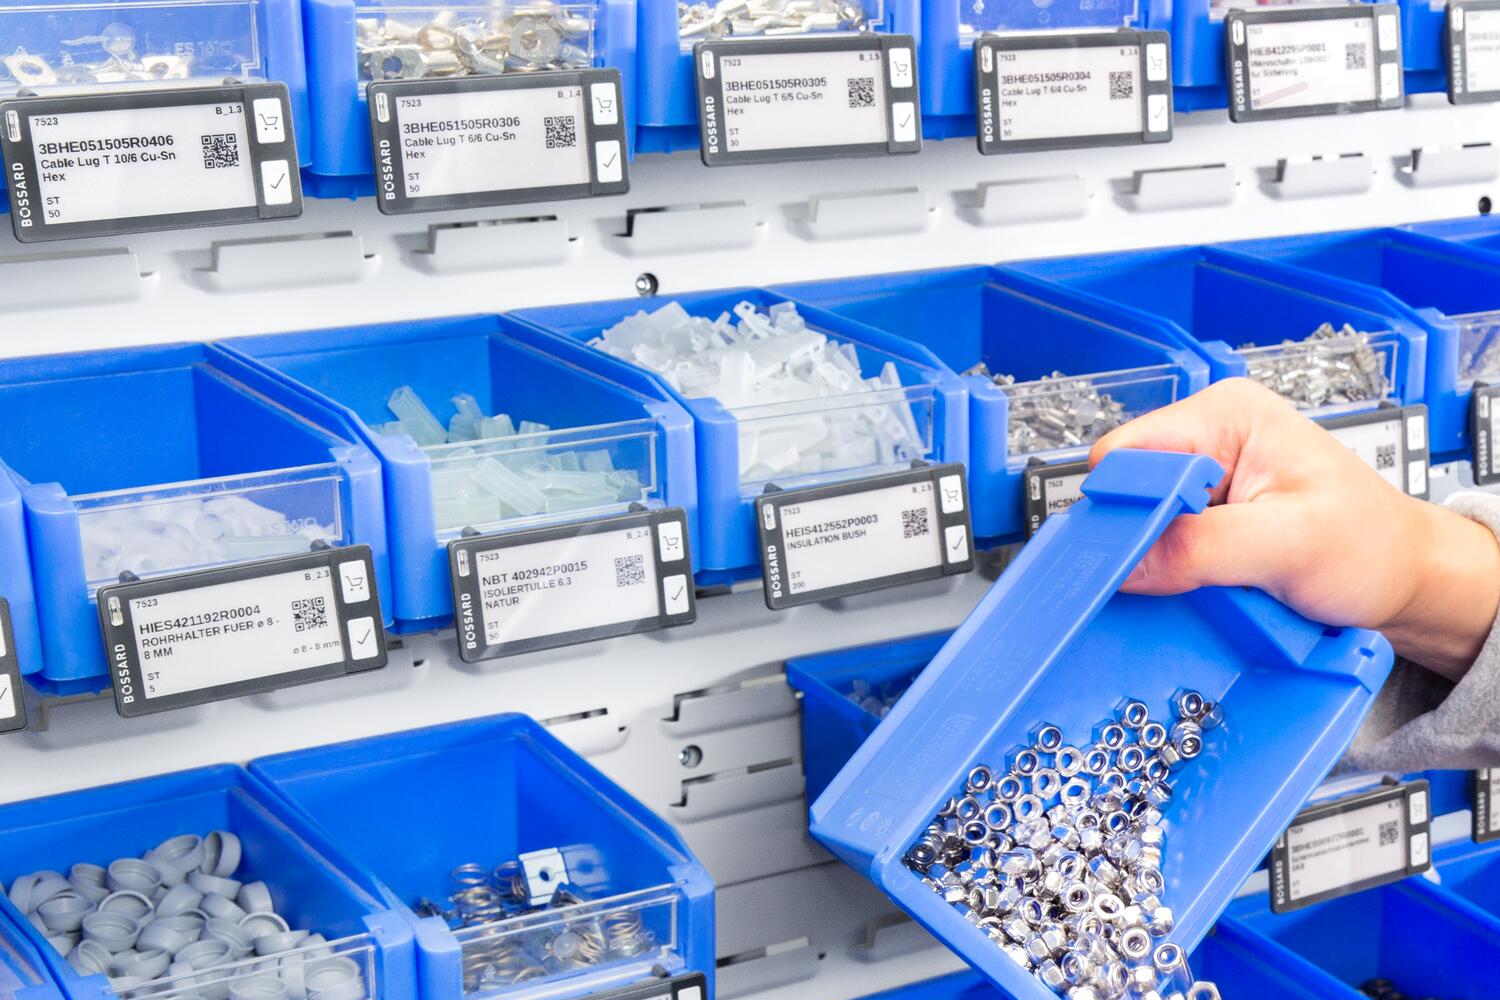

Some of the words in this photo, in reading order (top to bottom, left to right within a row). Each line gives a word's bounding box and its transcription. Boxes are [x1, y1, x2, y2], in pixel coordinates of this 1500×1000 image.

[723, 58, 741, 66] 7523
[725, 77, 827, 91] 3BHE051505R0305
[1001, 88, 1023, 96] Cable
[1025, 87, 1040, 96] Lug
[1063, 85, 1087, 93] Cu-Sn
[400, 99, 421, 107] 7523
[726, 95, 751, 104] Cable
[753, 94, 770, 104] Lug
[774, 93, 779, 101] T
[795, 91, 823, 100] Cu-Sn
[215, 105, 242, 116] B_1.3
[727, 106, 744, 115] Hex
[982, 89, 993, 142] BOSSARD
[34, 117, 58, 127] 7523
[403, 116, 520, 134] 3BHE051505R0306
[705, 96, 718, 153] BOSSARD
[728, 127, 738, 135] ST
[37, 134, 174, 155] 3BHE051505R0406
[404, 137, 433, 147] Cable
[436, 136, 455, 147] Lug
[458, 135, 466, 143] T
[468, 134, 482, 143] 6/6
[485, 131, 516, 142] Cu-Sn
[40, 158, 74, 169] Cable
[77, 156, 100, 168] Lug
[102, 155, 112, 165] T
[113, 153, 137, 164] 10/6
[140, 150, 176, 162] Cu-Sn
[405, 149, 425, 159] Hex
[380, 139, 395, 200] BOSSARD
[407, 172, 420, 180] ST
[42, 171, 65, 182] Hex
[13, 162, 32, 227] BOSSARD
[409, 184, 419, 192] 50
[46, 196, 60, 204] ST
[48, 210, 60, 218] 50
[783, 506, 800, 516] 7523
[785, 514, 878, 538] HEIS412552P0003
[787, 533, 840, 550] INSULATION
[841, 529, 866, 540] BUSH
[479, 552, 499, 562] 7523
[303, 569, 329, 581] B_2.3
[482, 573, 508, 586] NBT
[511, 560, 588, 581] 402942P0015
[768, 545, 782, 598] BOSSARD
[483, 579, 555, 598] ISOLIERTULLE
[558, 576, 571, 586] 6.3
[135, 598, 158, 609] 7523
[485, 596, 519, 609] NATUR
[139, 604, 260, 635] HIES421192R0004
[461, 593, 476, 650] BOSSARD
[487, 620, 499, 629] ST
[141, 626, 220, 649] ROHRHALTER
[222, 620, 254, 634] FUER
[266, 617, 273, 625] 8
[322, 639, 339, 647] mm
[143, 651, 150, 660] 8
[152, 647, 173, 658] MM
[115, 644, 134, 704] BOSSARD
[147, 671, 160, 680] ST
